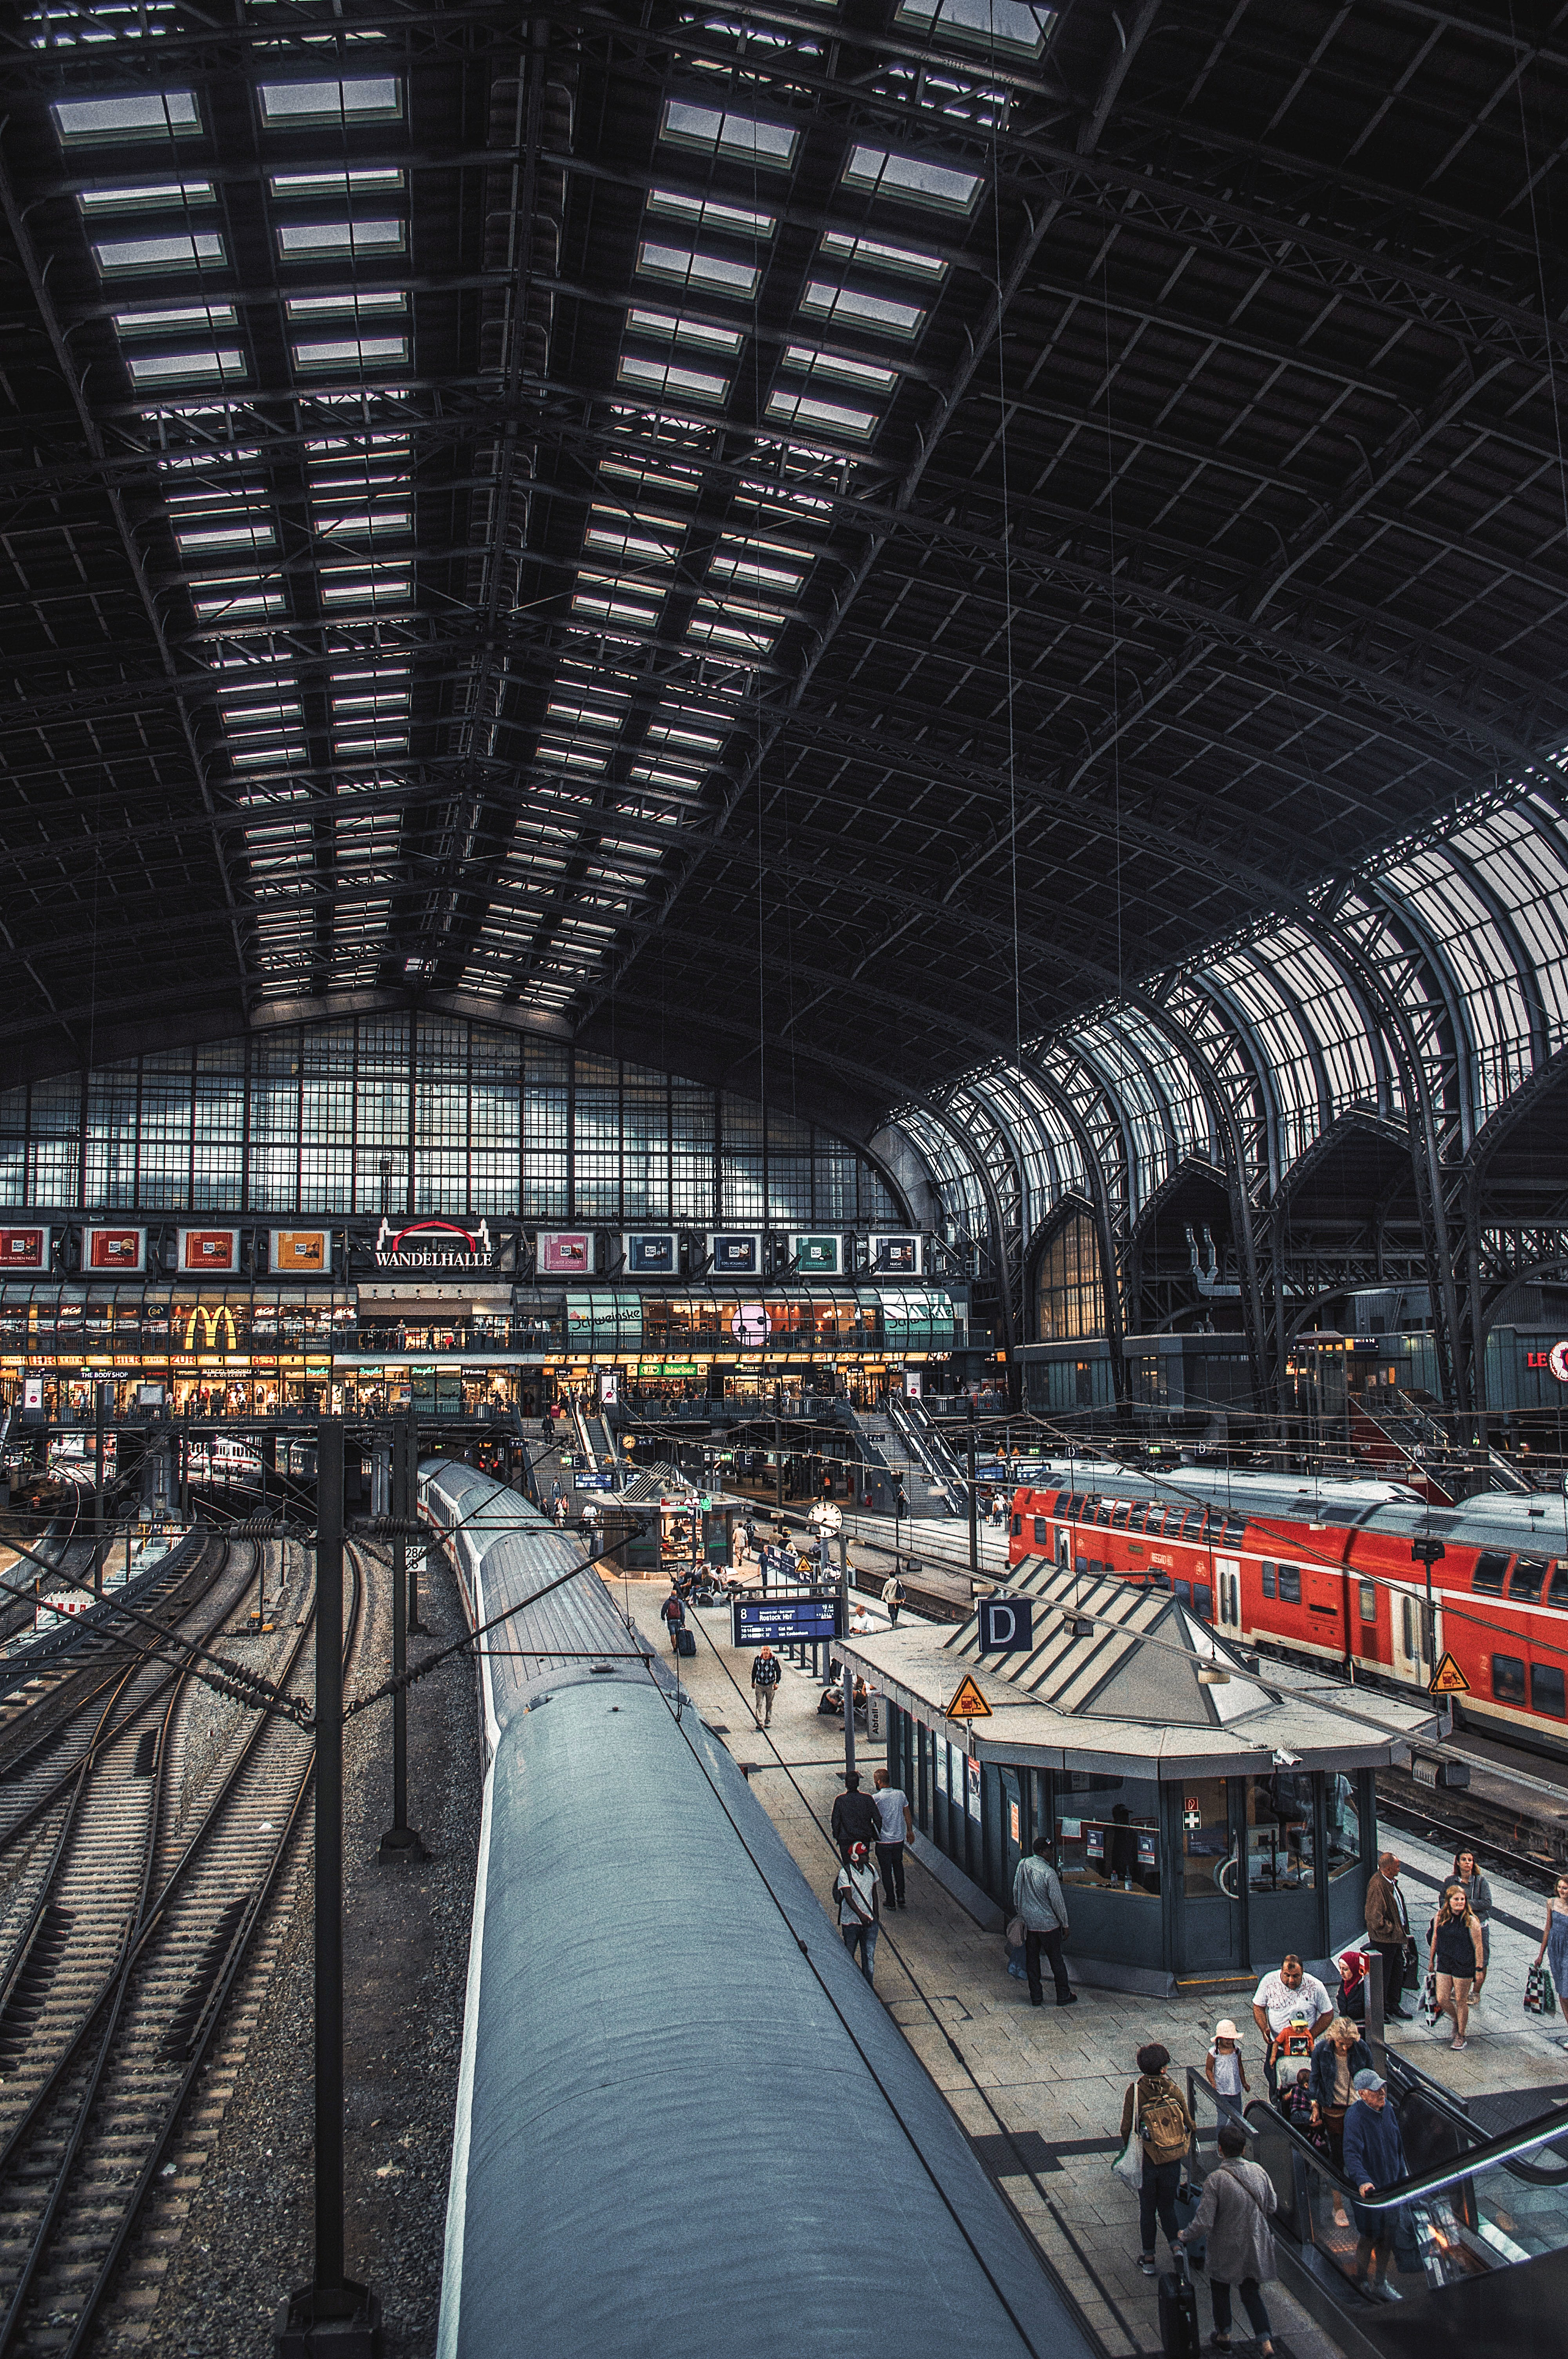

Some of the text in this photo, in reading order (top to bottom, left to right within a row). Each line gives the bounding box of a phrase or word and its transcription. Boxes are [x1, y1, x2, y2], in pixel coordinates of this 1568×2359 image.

[375, 1252, 492, 1266] WANDELHALLE
[1528, 1352, 1548, 1367] LE
[665, 1365, 695, 1374] bierbar
[1068, 1447, 1075, 1457] D
[573, 1456, 580, 1467] E
[745, 1454, 751, 1465] E
[1152, 1552, 1166, 1565] REGIO
[741, 1608, 747, 1619] 8
[989, 1606, 1016, 1644] D
